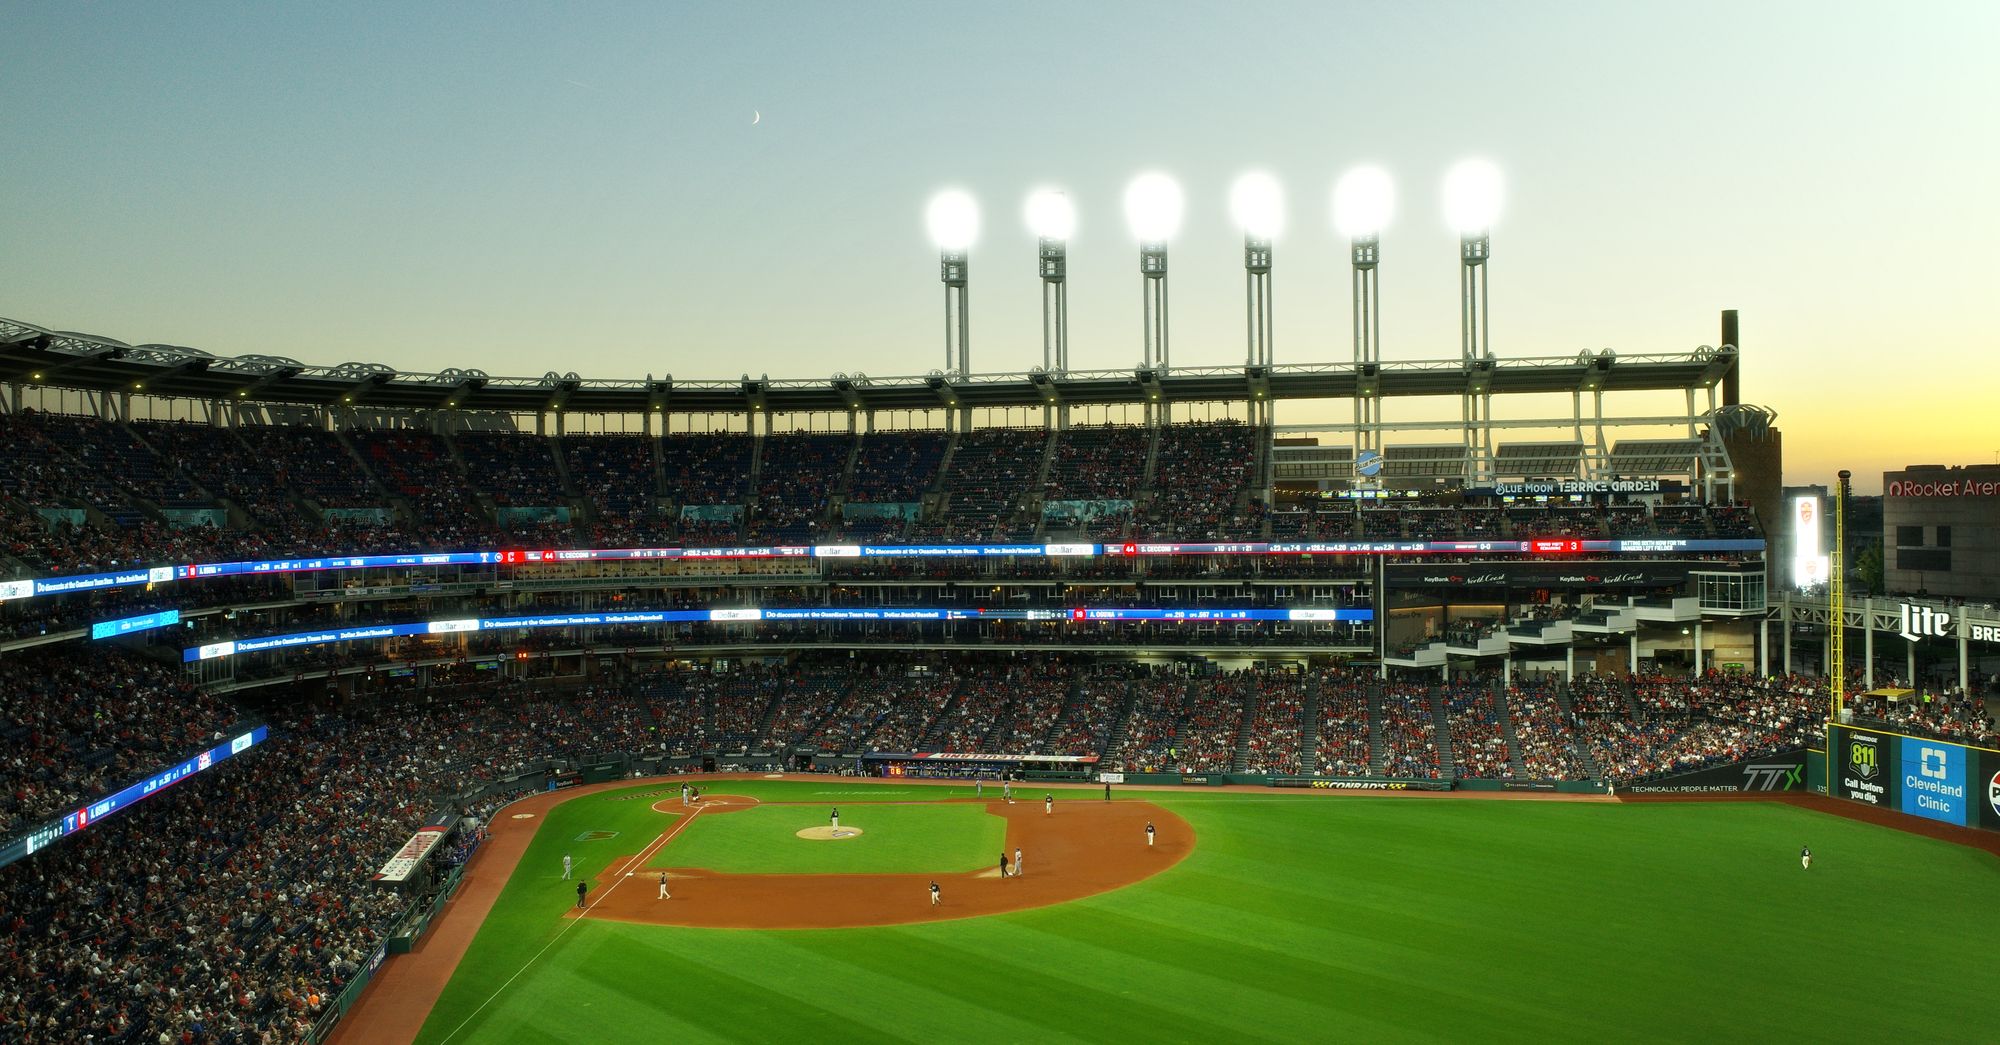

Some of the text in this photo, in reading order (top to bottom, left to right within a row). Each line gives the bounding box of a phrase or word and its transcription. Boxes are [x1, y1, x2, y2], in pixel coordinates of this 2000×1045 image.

[1496, 481, 1659, 495] BLUE MOON TERRACE GARDEN
[1904, 480, 1959, 496] Rocket
[480, 553, 489, 562] T
[508, 552, 514, 562] C
[1464, 575, 1484, 585] North
[1600, 575, 1621, 584] North
[1899, 603, 1950, 642] Lite
[1852, 744, 1874, 766] 811
[1743, 764, 1803, 791] TTX
[1844, 778, 1884, 794] Call before
[1906, 775, 1962, 798] Cleveland
[1851, 791, 1878, 803] you dig.
[1918, 795, 1950, 812] Clinic
[68, 818, 74, 830] T
